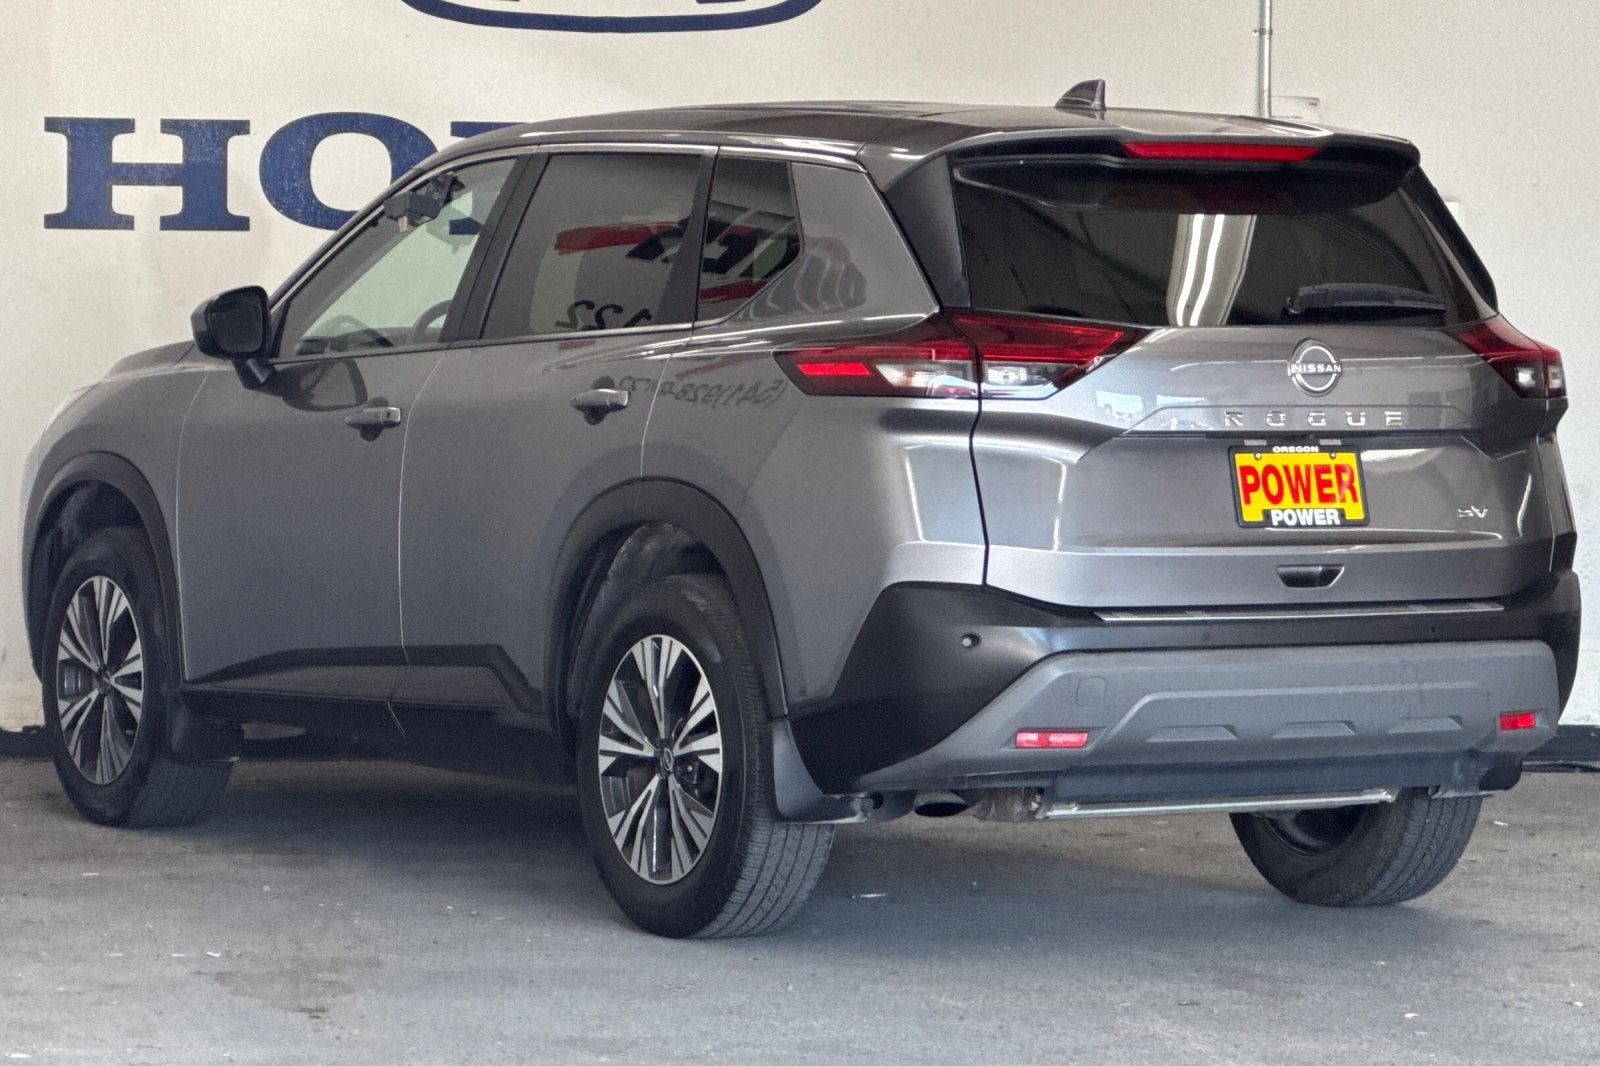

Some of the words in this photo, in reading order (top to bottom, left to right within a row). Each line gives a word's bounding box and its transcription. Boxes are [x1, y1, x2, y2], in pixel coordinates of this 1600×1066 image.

[44, 111, 530, 231] HO
[1290, 363, 1341, 373] NISSAN
[1224, 410, 1403, 427] ROGUE
[1272, 445, 1319, 453] OREGON
[1239, 464, 1359, 505] POWER
[1270, 508, 1341, 526] POWER
[1457, 505, 1489, 519] SV
